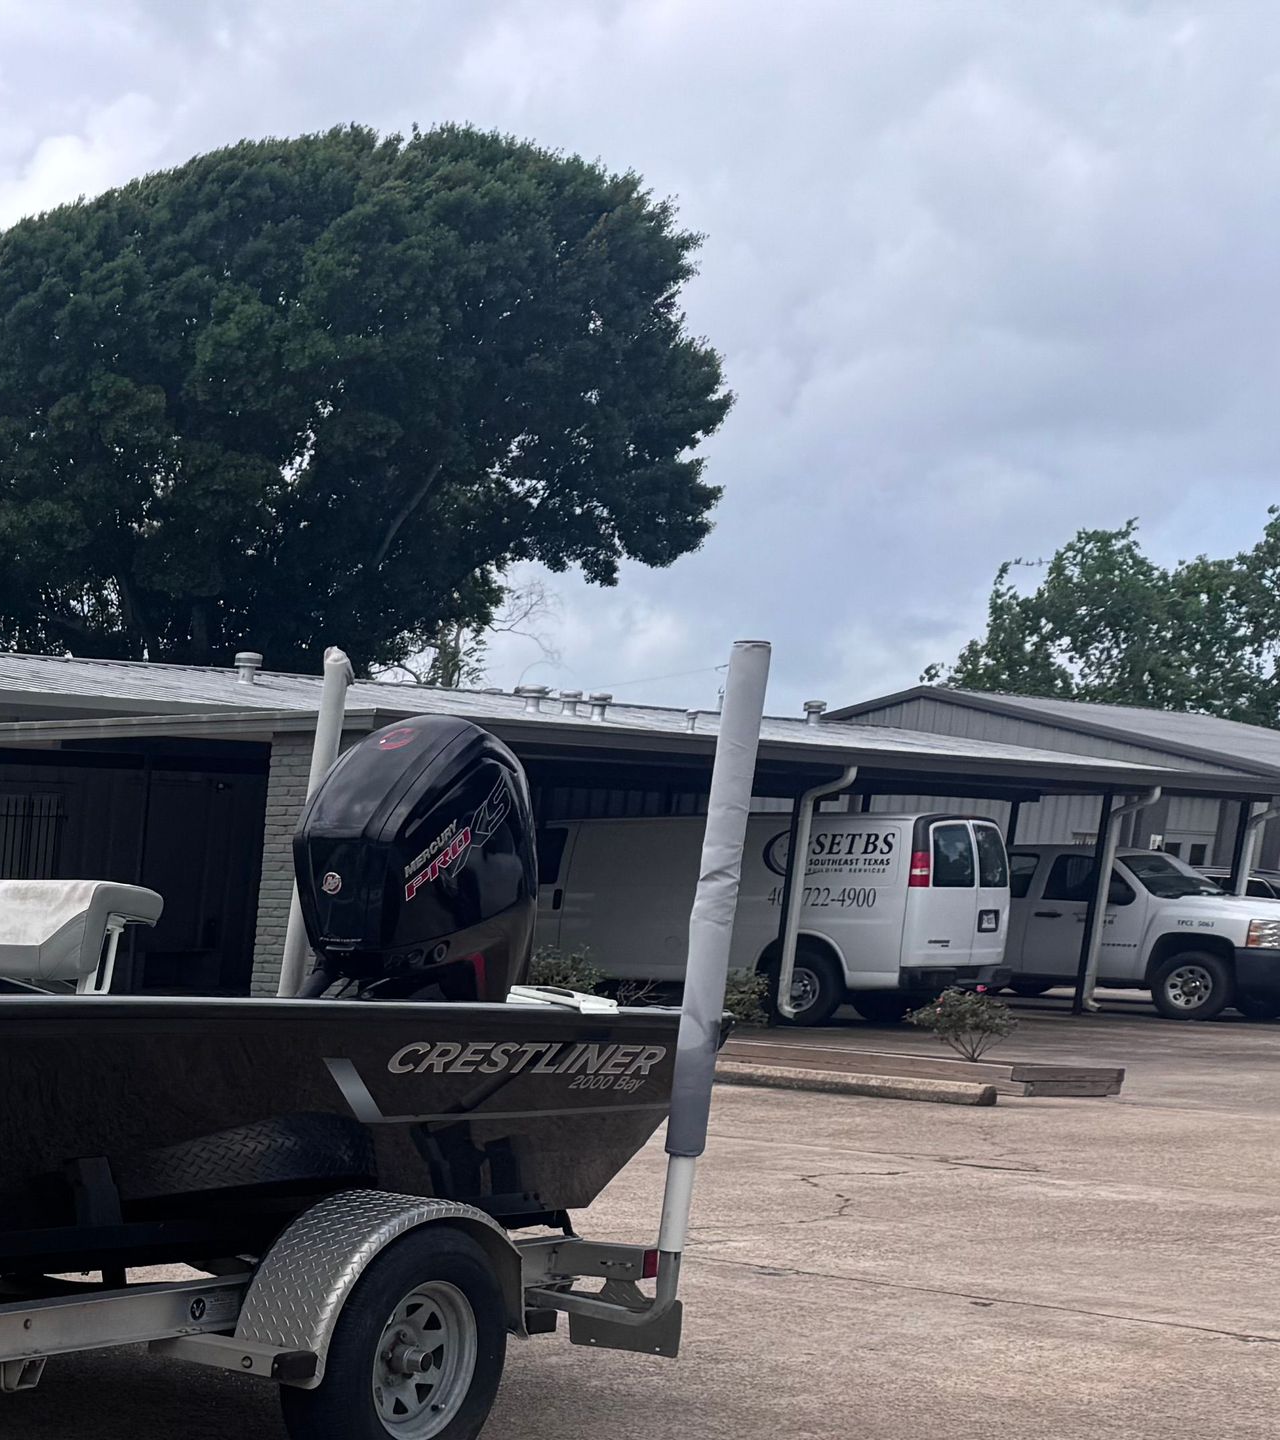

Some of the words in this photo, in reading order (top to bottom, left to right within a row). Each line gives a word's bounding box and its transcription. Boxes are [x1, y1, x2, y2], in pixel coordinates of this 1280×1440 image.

[404, 818, 458, 878] MERCURY
[812, 832, 896, 855] SETBS
[405, 827, 471, 901] PRO
[808, 858, 859, 866] SOUTHEAST
[863, 858, 890, 866] TEXAS
[387, 1041, 666, 1075] CRESTLINER
[568, 1075, 613, 1090] 2000
[613, 1076, 646, 1094] Bay
